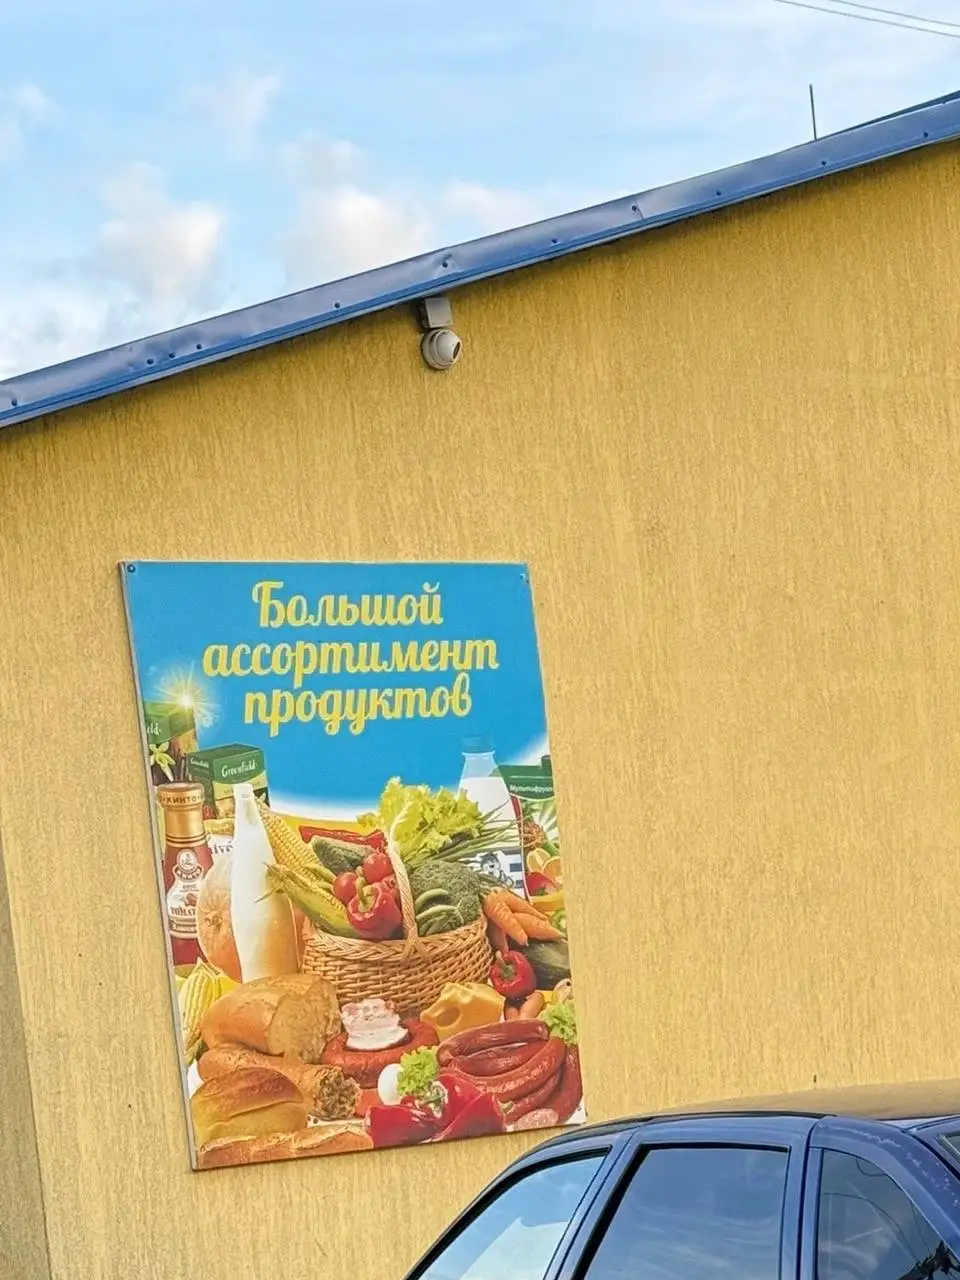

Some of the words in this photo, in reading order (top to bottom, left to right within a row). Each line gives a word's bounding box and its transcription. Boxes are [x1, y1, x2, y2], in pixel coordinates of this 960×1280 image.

[252, 579, 444, 629] Большой
[202, 638, 499, 689] ассортимент
[244, 671, 473, 738] продуктов
